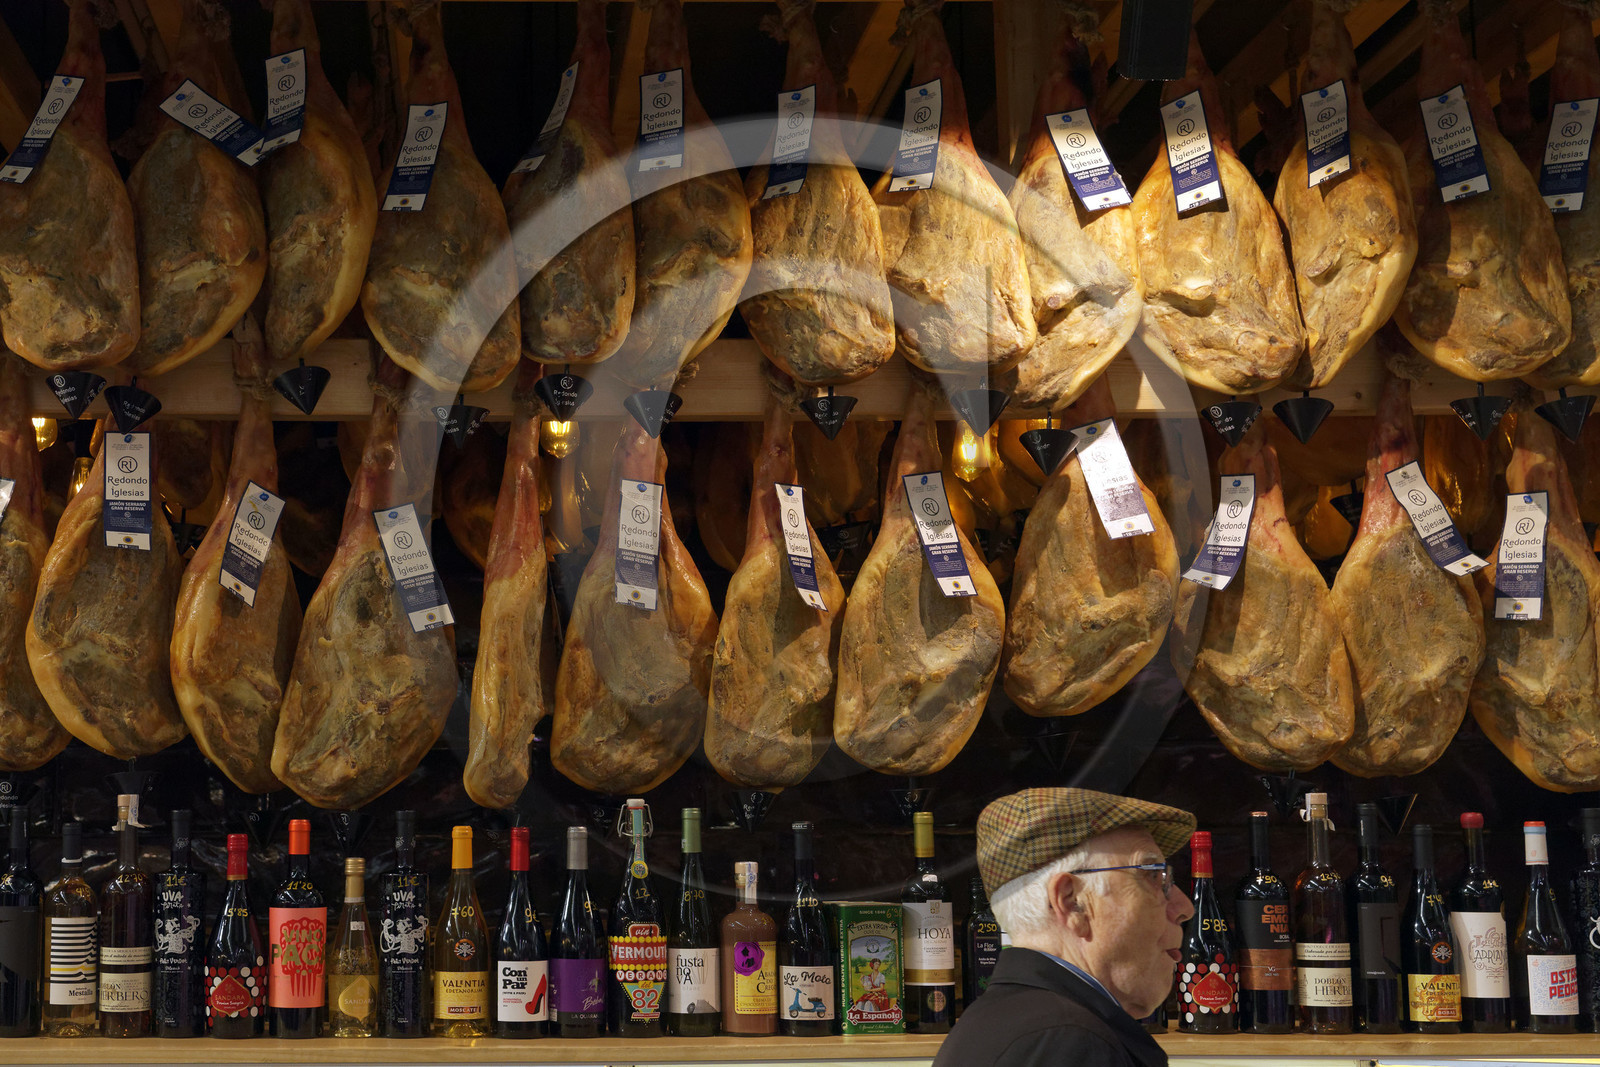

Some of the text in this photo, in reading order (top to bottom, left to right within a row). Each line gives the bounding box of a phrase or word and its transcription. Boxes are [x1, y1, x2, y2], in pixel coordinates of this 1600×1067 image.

[644, 109, 681, 121] Redondo
[903, 123, 938, 137] Redondo
[1309, 116, 1346, 136] Redondo
[1431, 125, 1471, 145] Redondo
[1170, 132, 1207, 152] Redondo
[1548, 138, 1589, 151] Redondo
[402, 143, 437, 154] Redondo
[1062, 147, 1102, 161] Redondo
[107, 476, 148, 485] Redondo
[111, 487, 145, 498] Iglesias
[1412, 504, 1443, 522] Redondo
[919, 519, 951, 530] Redondo
[1214, 521, 1247, 531] Redondo
[235, 523, 268, 547] Redondo
[621, 524, 658, 539] Redondo
[785, 529, 808, 541] Redondo
[1503, 537, 1541, 547] Redondo
[390, 550, 427, 565] Redondo
[1505, 548, 1538, 560] Iglesias
[166, 874, 186, 887] 11€
[398, 876, 419, 887] 11€
[162, 890, 184, 902] UVA
[393, 890, 415, 902] UVA
[452, 906, 474, 918] 7'60
[978, 923, 997, 933] 2'50
[1202, 919, 1228, 932] 5'85
[283, 929, 323, 942] VINO
[918, 928, 951, 939] HOYA
[271, 944, 326, 966] PAC
[676, 954, 704, 968] fusta
[502, 967, 527, 977] Con
[676, 967, 691, 976] no
[502, 979, 527, 989] Par
[784, 972, 831, 986] La Moto
[632, 989, 659, 1009] 82
[862, 1011, 900, 1020] Española
